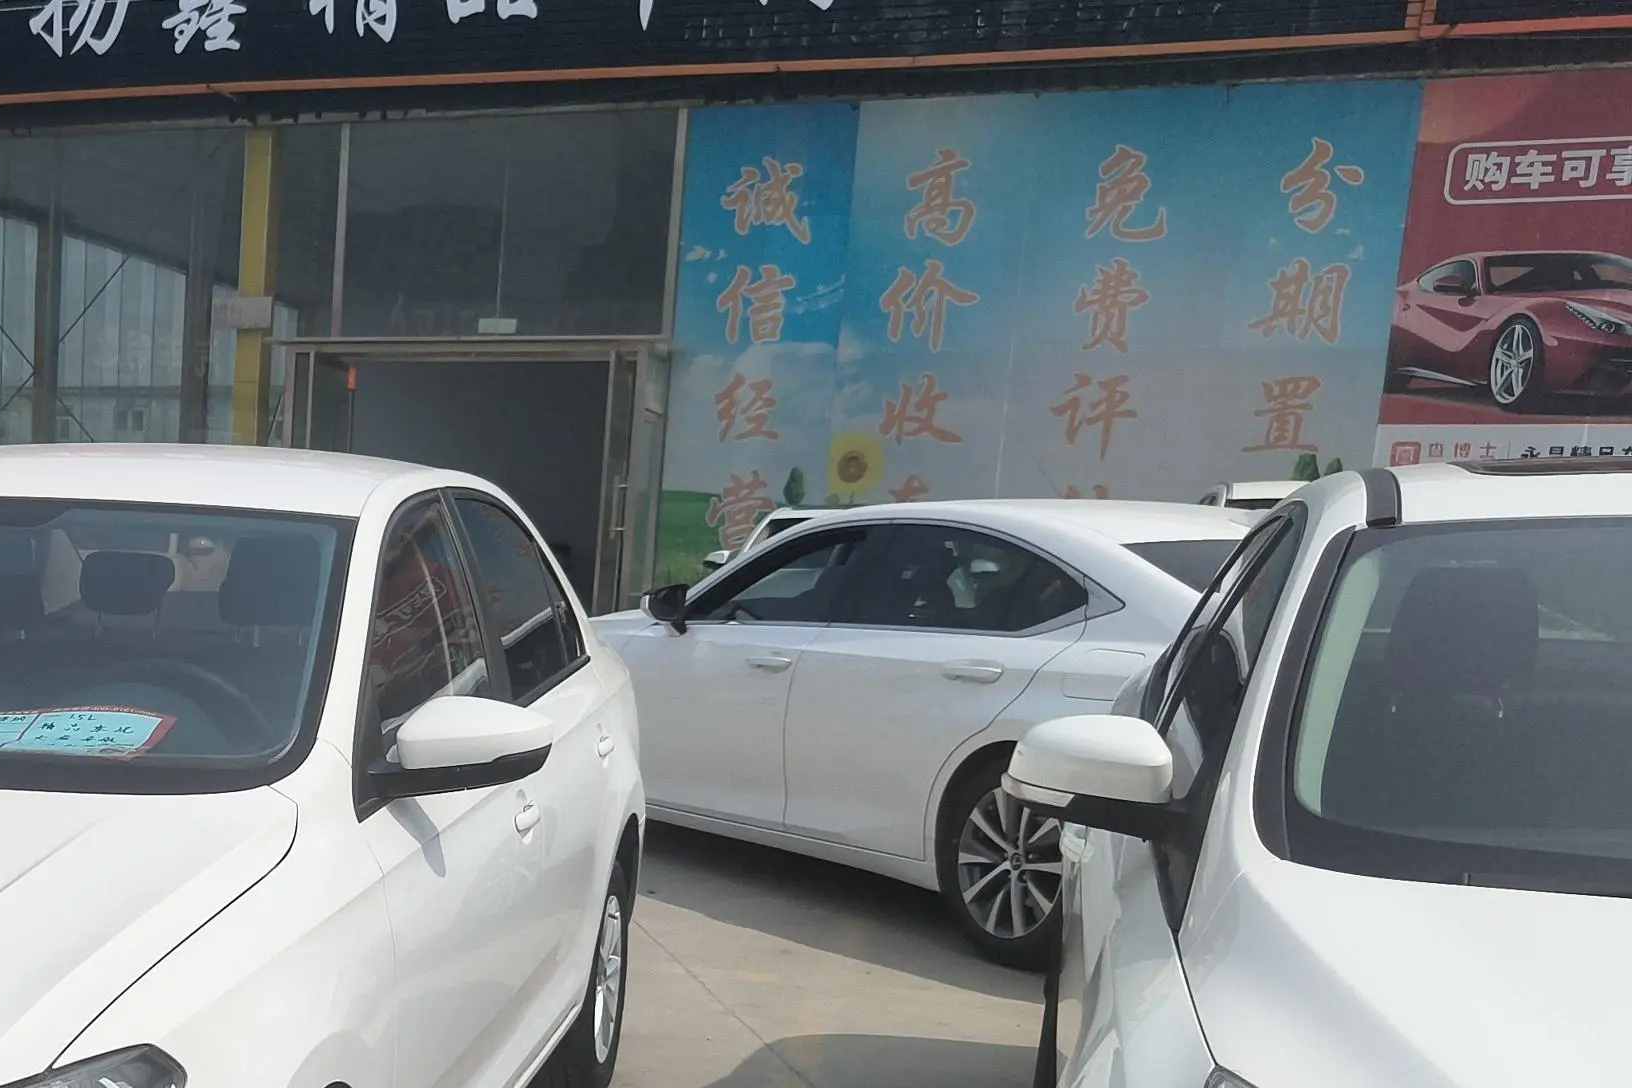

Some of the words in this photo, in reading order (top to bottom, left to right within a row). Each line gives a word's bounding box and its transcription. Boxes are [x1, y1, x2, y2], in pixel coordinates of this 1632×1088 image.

[705, 155, 812, 551] 诚信经营
[1049, 143, 1168, 500] 免费评
